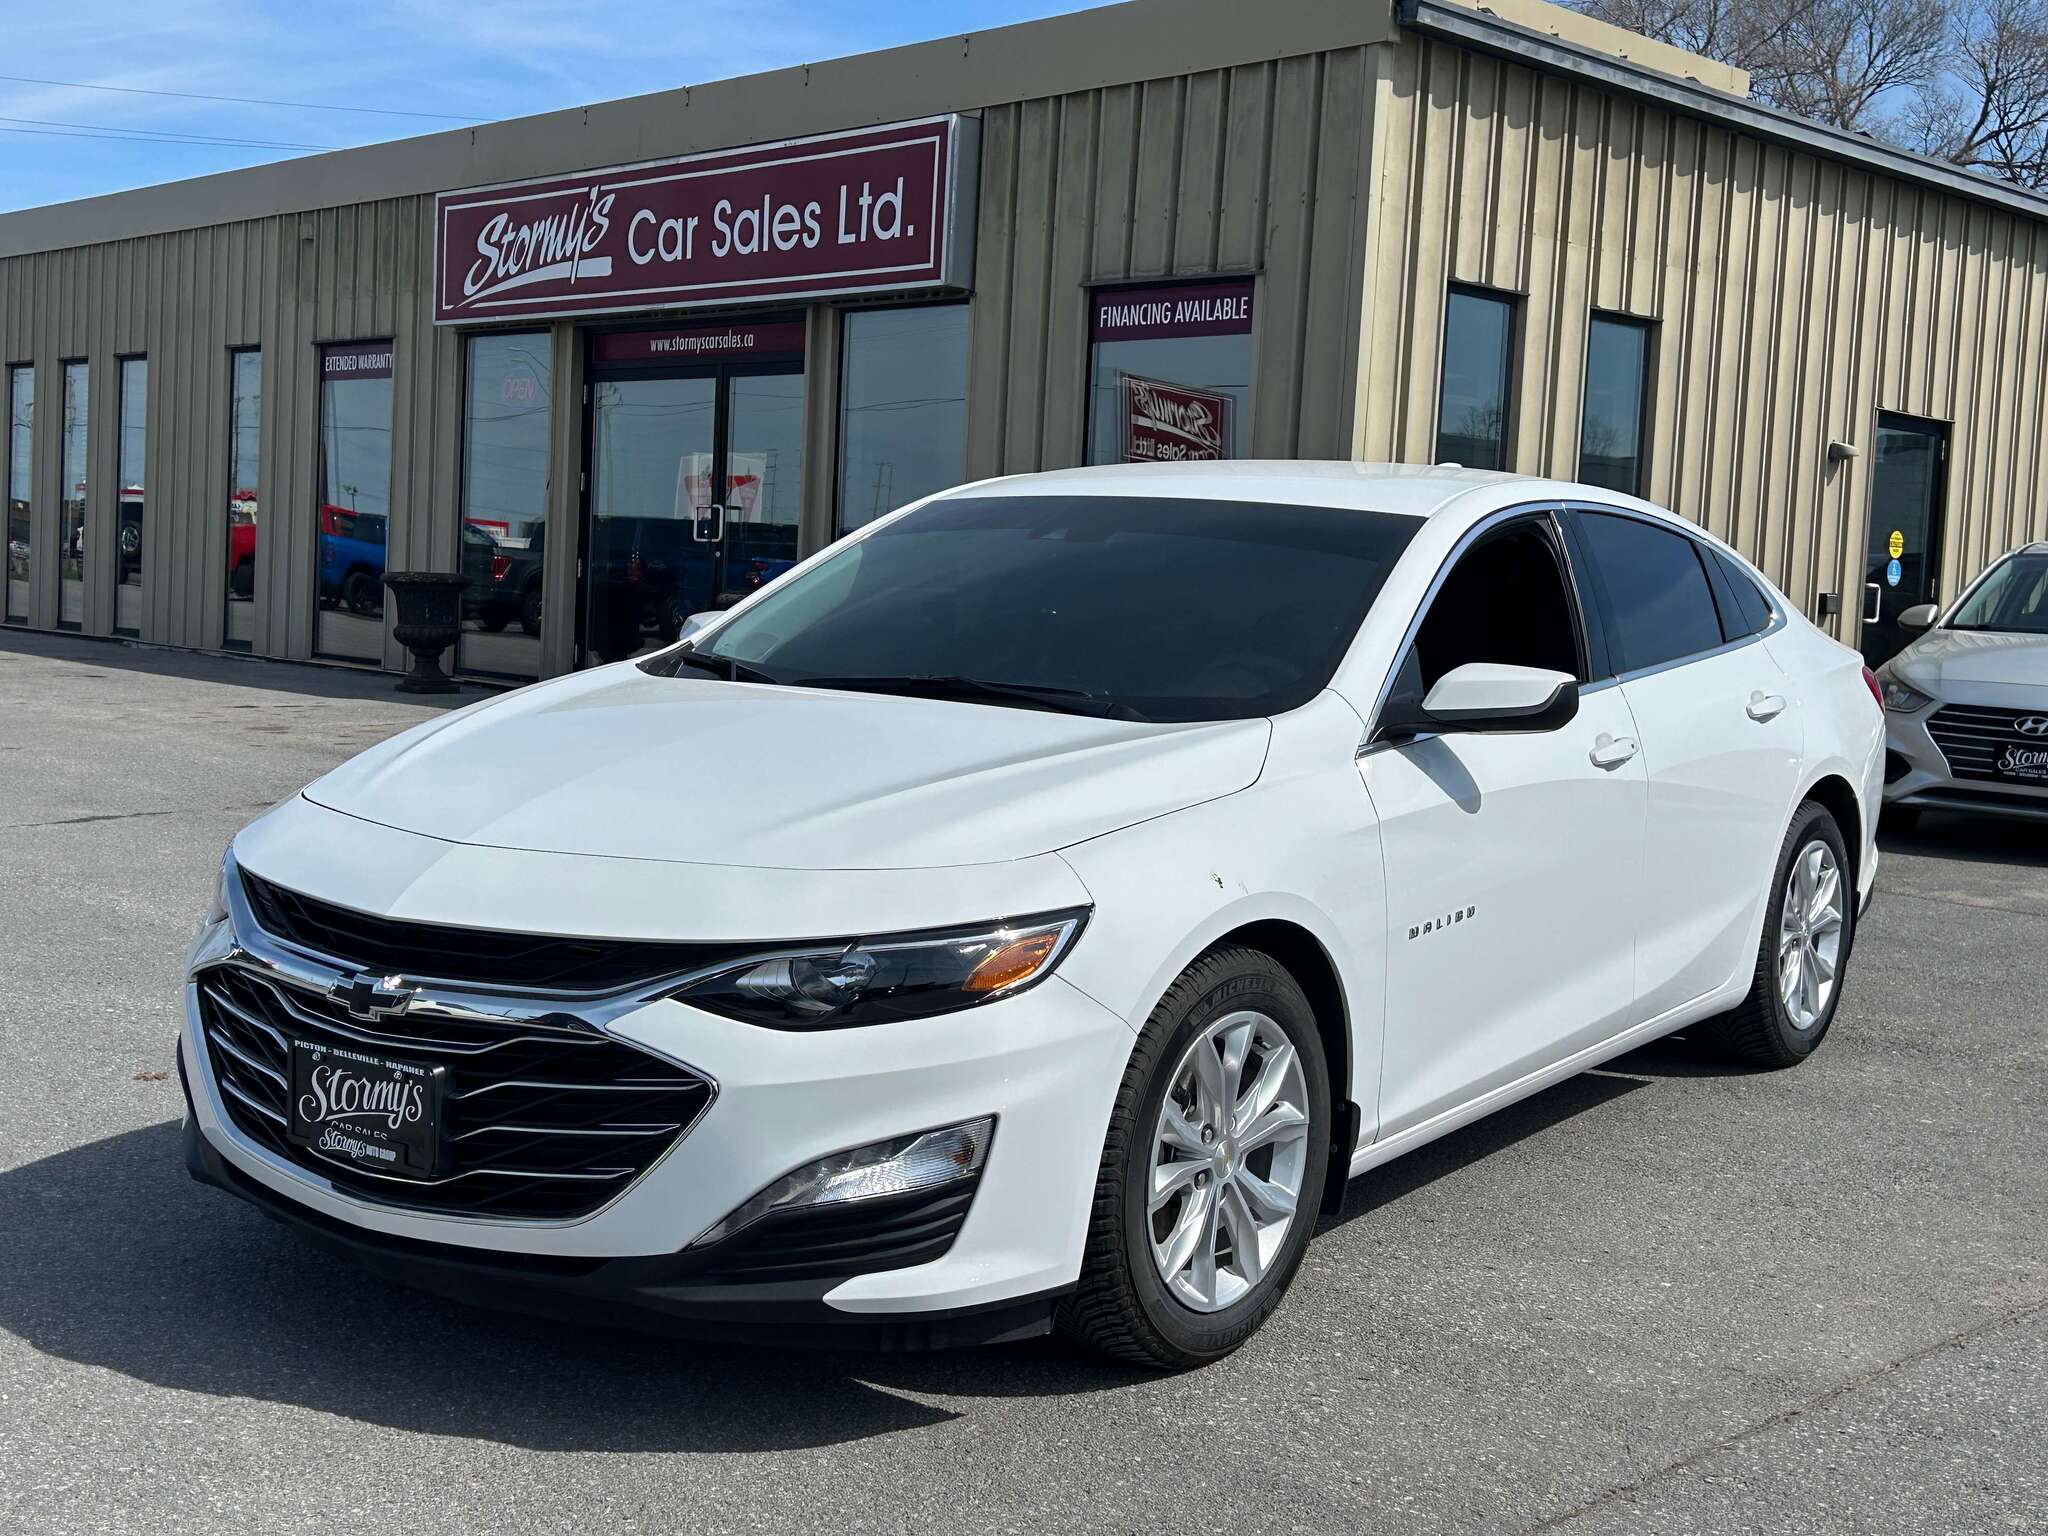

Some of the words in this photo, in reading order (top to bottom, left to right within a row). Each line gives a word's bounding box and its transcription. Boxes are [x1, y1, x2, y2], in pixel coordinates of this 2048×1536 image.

[463, 185, 616, 296] Stormy's
[628, 208, 699, 265] Car
[711, 194, 821, 258] Sales
[837, 176, 915, 245] Ltd.
[1100, 302, 1171, 328] FINANCING
[1174, 296, 1249, 323] AVAILABLE
[650, 328, 754, 355] www.stormyscarsales.ca
[325, 355, 358, 371] EXTENDED
[358, 353, 393, 369] WARRANTY
[1408, 905, 1476, 940] MALIBU
[294, 1039, 327, 1053] PICTON
[333, 1048, 380, 1066] BELLEVILLE
[386, 1061, 425, 1077] NAPANEE
[299, 1065, 423, 1129] Stormy's
[318, 1127, 366, 1158] Stormy's
